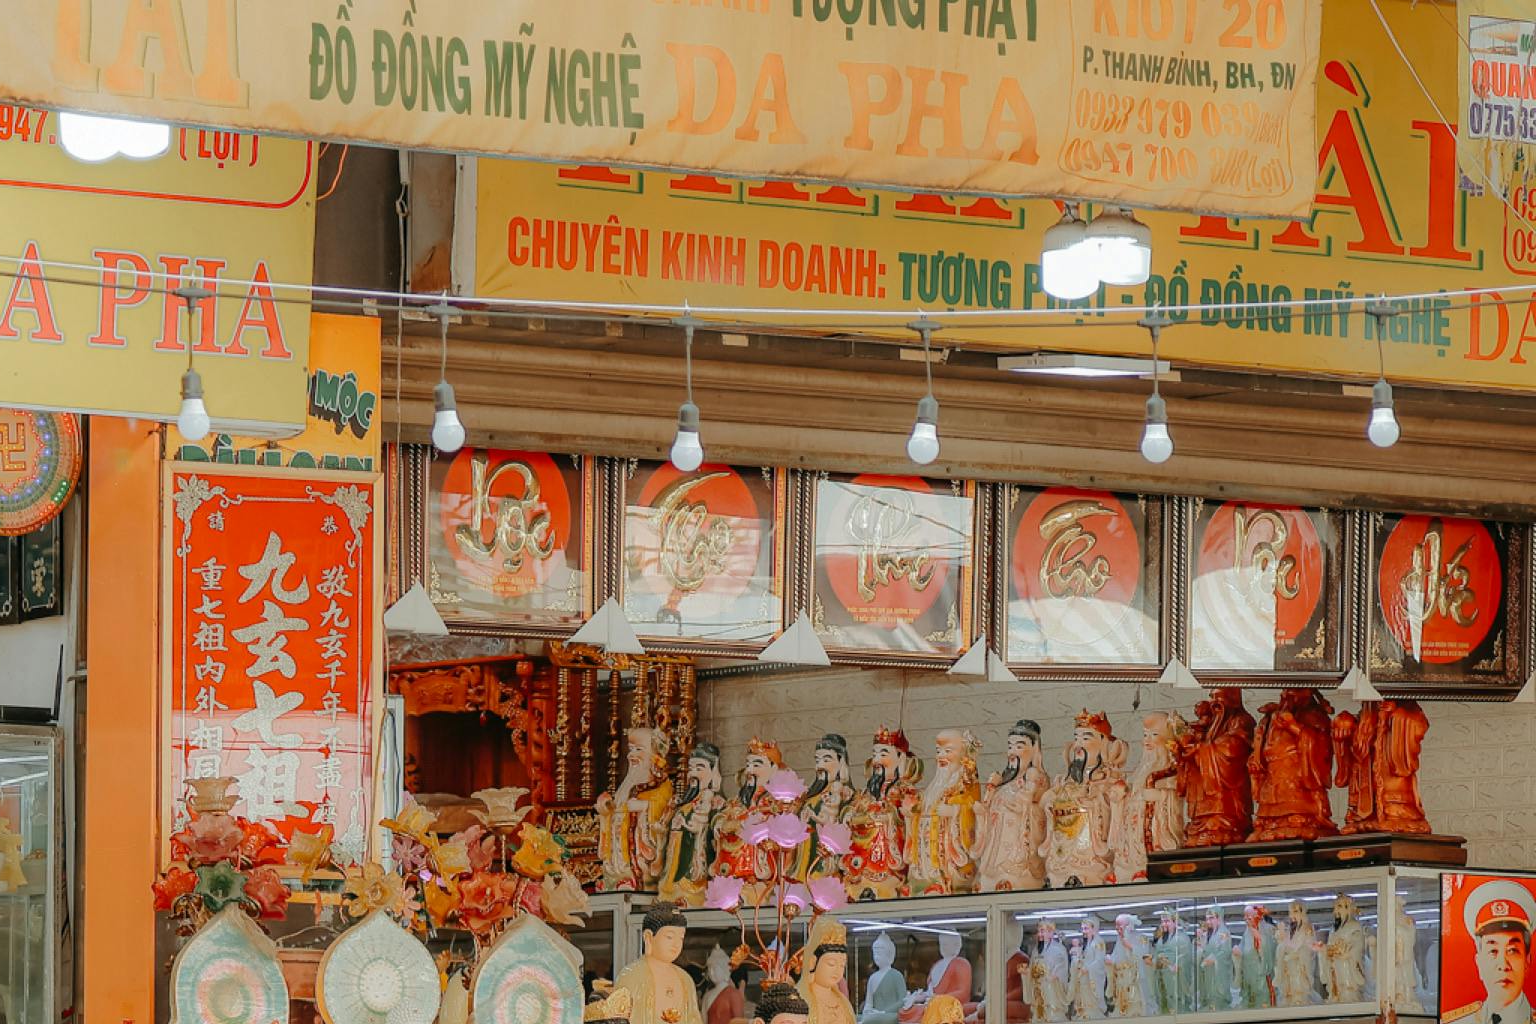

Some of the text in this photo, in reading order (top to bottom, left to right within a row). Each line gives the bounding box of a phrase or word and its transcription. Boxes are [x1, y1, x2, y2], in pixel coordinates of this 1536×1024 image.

[372, 0, 470, 115] ĐỒNG
[484, 22, 536, 121] MỸ
[544, 32, 644, 146] NGHỆ
[666, 42, 1039, 166] DA PHA
[1102, 49, 1165, 83] THANH
[1225, 61, 1263, 92] BH,
[1178, 60, 1472, 262] ÀI
[91, 248, 293, 361] PHA
[508, 214, 648, 279] CHUYÊN
[660, 230, 746, 287] KINH
[758, 239, 886, 299] DOANH:
[899, 250, 1011, 314] TƯỢNG
[1146, 259, 1189, 324] ĐỒ
[1200, 264, 1291, 333] ĐỒNG
[1303, 282, 1354, 339] MỸ
[1365, 289, 1451, 357] NGHỆ
[315, 369, 377, 431] MỘC
[231, 530, 311, 824] 九玄七祖
